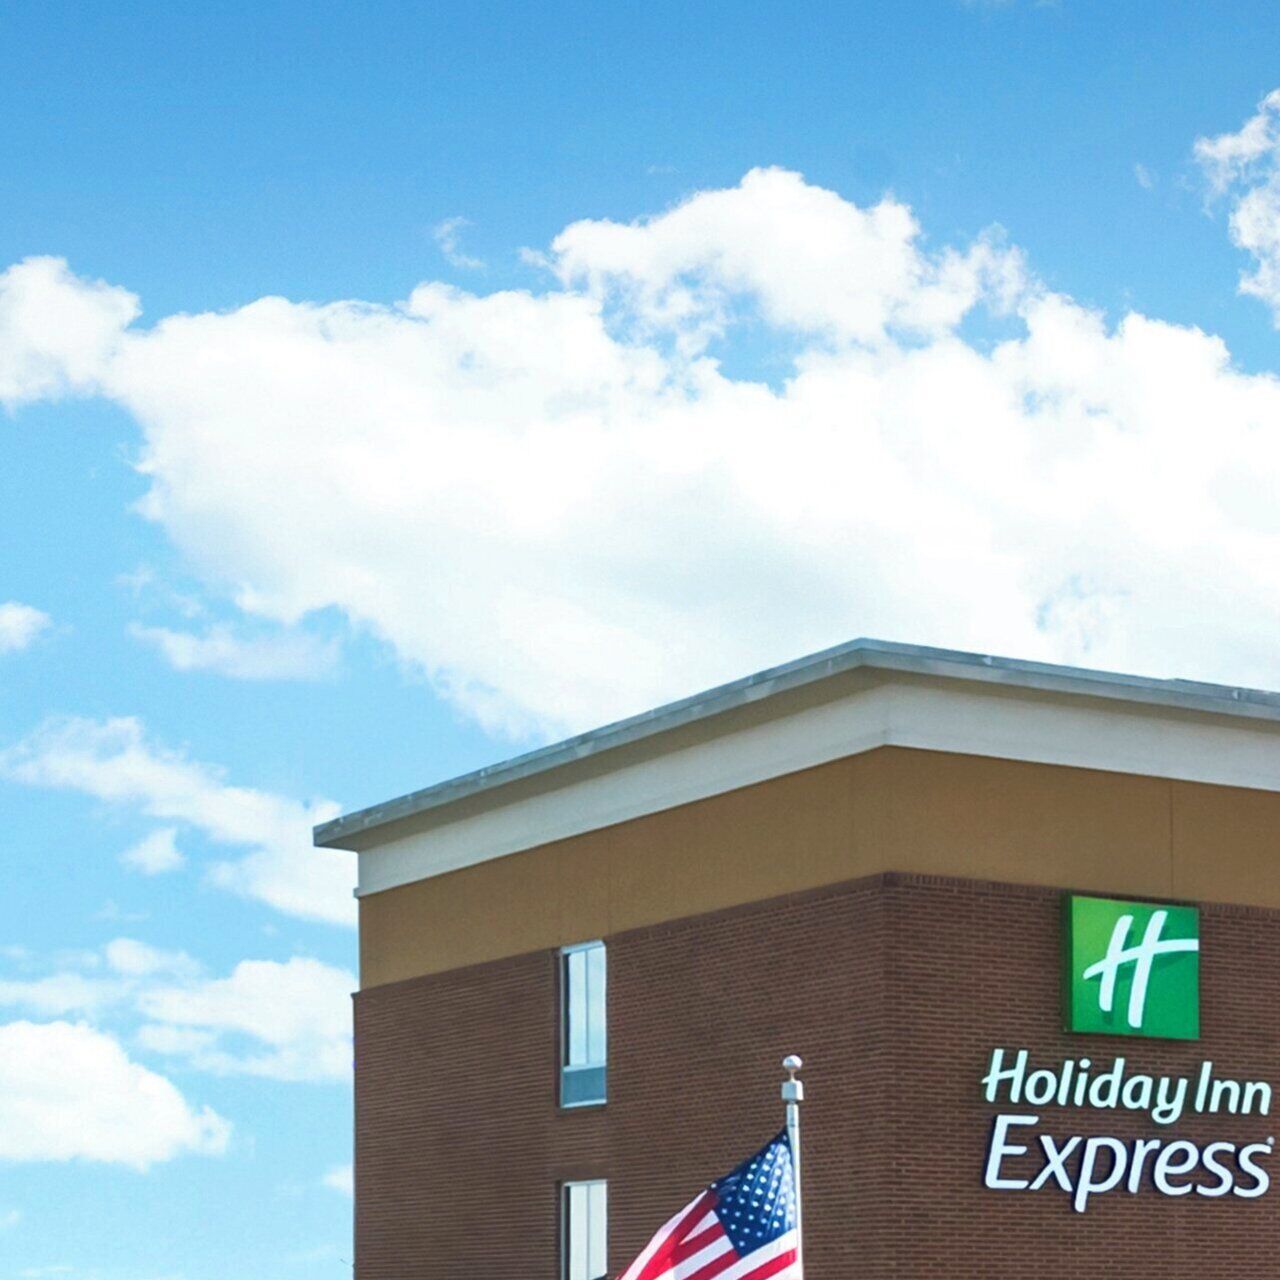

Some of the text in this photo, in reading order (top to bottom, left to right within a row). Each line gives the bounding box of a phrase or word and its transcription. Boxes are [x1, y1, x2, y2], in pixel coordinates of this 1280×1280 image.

[1083, 910, 1199, 1028] H
[981, 1048, 1272, 1124] Holiday Inn
[984, 1114, 1274, 1213] Express
